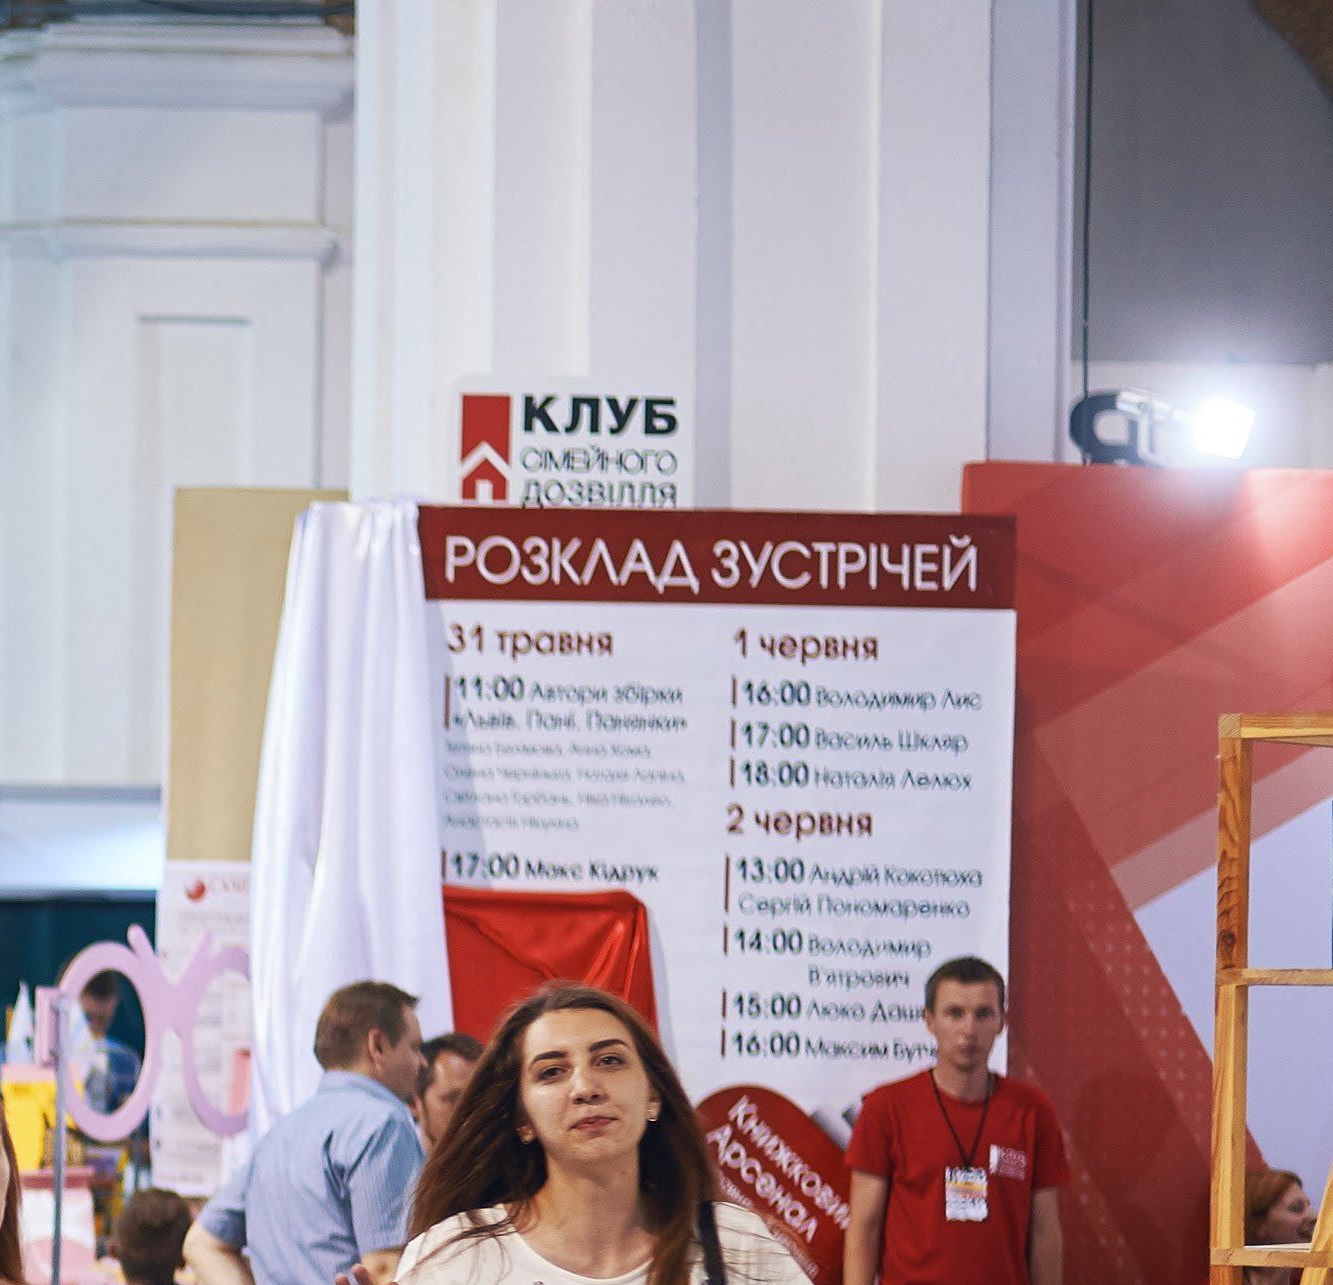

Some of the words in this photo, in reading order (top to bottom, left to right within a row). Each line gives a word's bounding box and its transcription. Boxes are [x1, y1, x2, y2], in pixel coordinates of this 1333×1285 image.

[523, 395, 678, 436] КЛУБ
[520, 443, 678, 475] СІМЕЙНОГО
[520, 479, 678, 509] ДОЗВІЛЛЯ
[444, 536, 700, 595] РОЗКЛАД
[711, 533, 978, 592] ЗУСТРІЧЕЙ
[447, 622, 485, 653] 31
[495, 629, 614, 661] травня
[734, 626, 748, 659] 1
[759, 634, 880, 666] червня
[454, 674, 525, 701] 11:00
[742, 680, 812, 707] 16:00
[741, 720, 811, 749] 17:00
[815, 727, 894, 751] Василь
[898, 728, 970, 757] Шкляр
[740, 760, 810, 788] 18:00
[726, 803, 745, 835] 2
[754, 811, 874, 842] червня
[450, 852, 521, 879] 17:00
[524, 858, 583, 881] Макс
[736, 857, 806, 883] 13:00
[735, 927, 804, 955] 14:00
[808, 932, 932, 962] Володимир
[735, 992, 803, 1019] 15:00
[734, 1031, 801, 1058] 16:00
[705, 1123, 819, 1244] Арсенал
